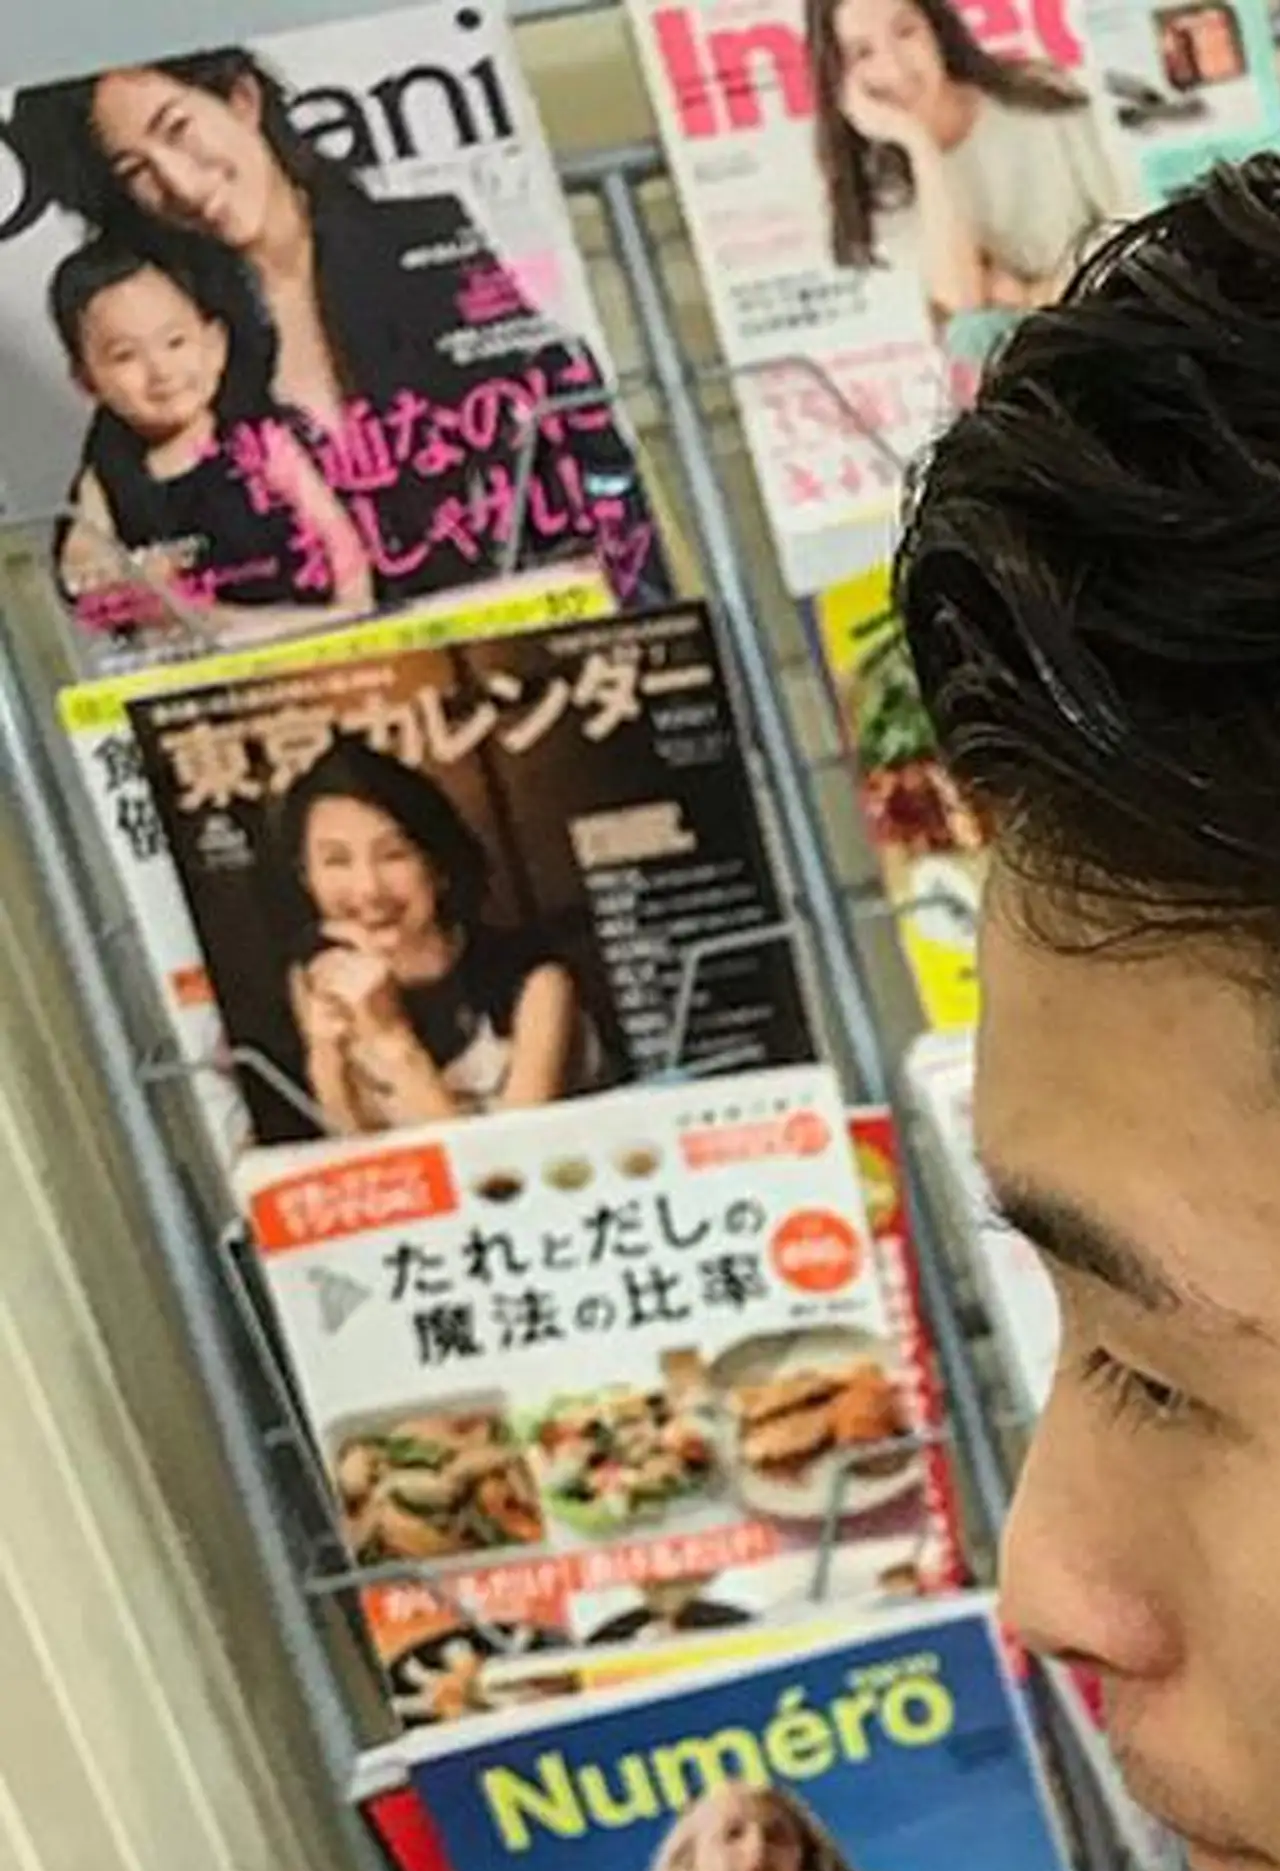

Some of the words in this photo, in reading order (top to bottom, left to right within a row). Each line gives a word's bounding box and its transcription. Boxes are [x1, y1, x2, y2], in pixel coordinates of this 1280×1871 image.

[380, 1193, 768, 1301] たれとだしの
[411, 1255, 771, 1364] 魔法の比率
[480, 1674, 956, 1852] Numéro
